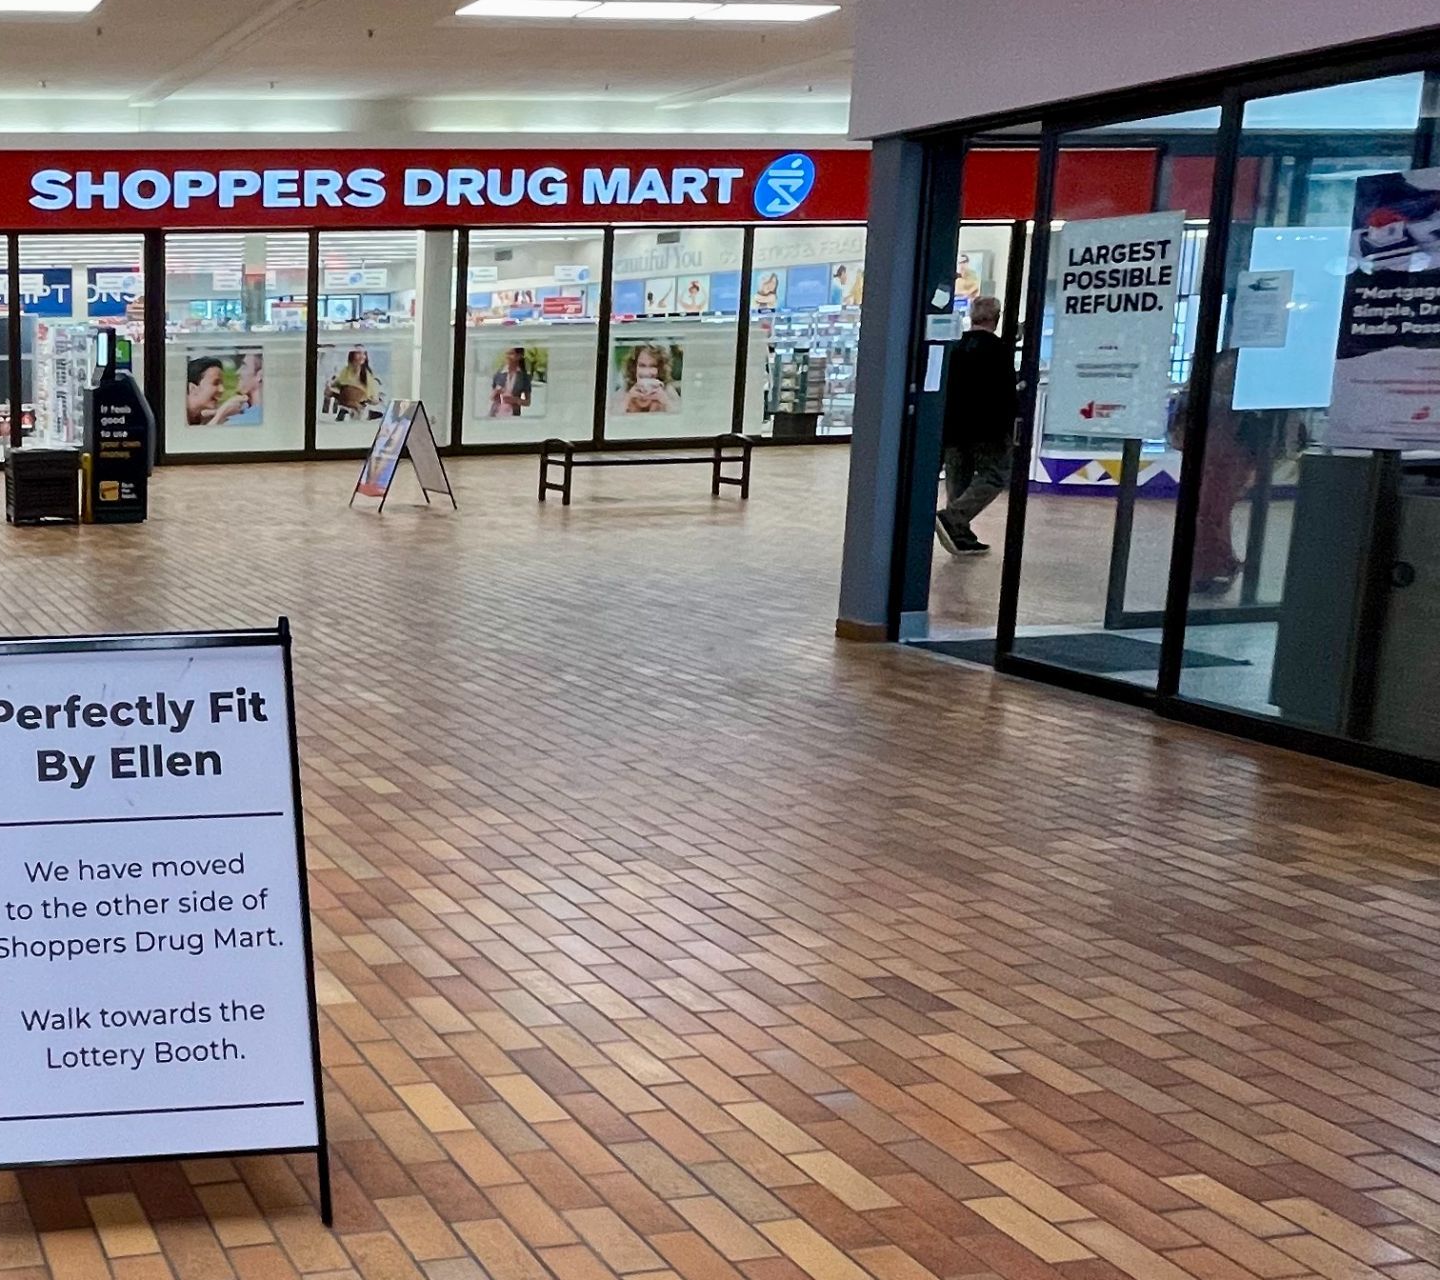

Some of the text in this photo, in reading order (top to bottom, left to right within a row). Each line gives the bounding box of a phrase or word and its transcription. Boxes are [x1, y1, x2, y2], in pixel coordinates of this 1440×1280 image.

[27, 166, 745, 211] SHOPPERS DRUG MART
[615, 246, 670, 274] eautiful
[670, 244, 703, 269] You
[1068, 239, 1171, 267] LARGEST
[1062, 265, 1172, 291] POSSIBLE
[1064, 292, 1164, 315] REFUND.
[1353, 303, 1416, 319] Simple,
[1351, 321, 1398, 336] Made
[209, 686, 269, 724] Fit
[36, 743, 223, 790] By Ellen
[23, 852, 245, 883] We have moved
[5, 887, 269, 921] to the other side of
[135, 930, 204, 956] Drug
[213, 926, 284, 949] Mart.
[20, 999, 266, 1032] Walk towards the
[46, 1037, 247, 1071] Lottery Booth.
